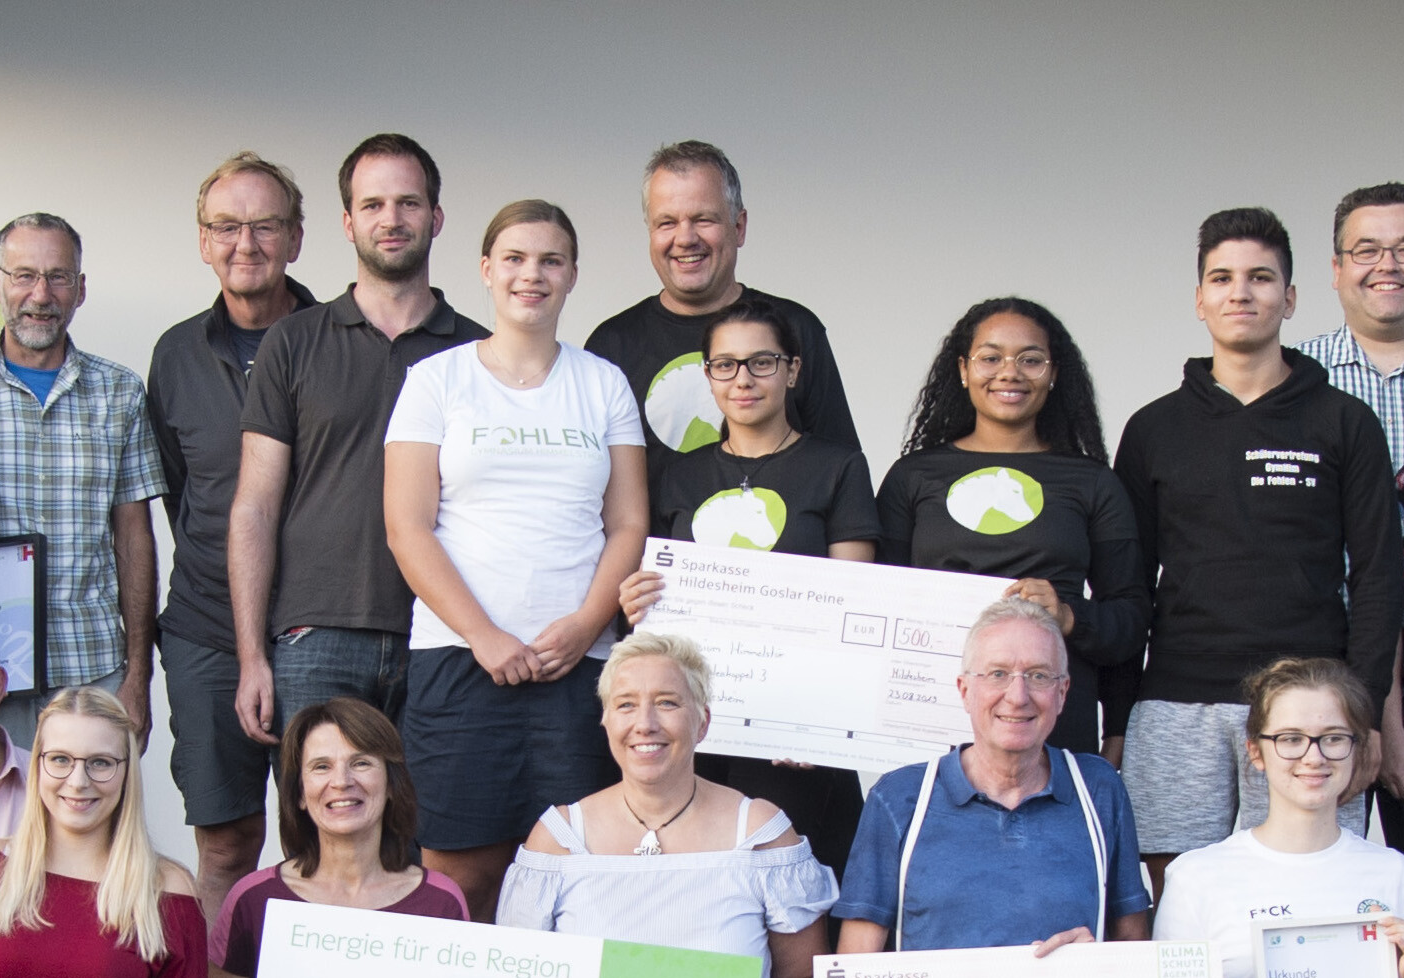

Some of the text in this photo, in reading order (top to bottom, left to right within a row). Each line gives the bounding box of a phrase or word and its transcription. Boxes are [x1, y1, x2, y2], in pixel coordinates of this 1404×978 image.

[681, 559, 750, 577] Sparkasse
[679, 577, 845, 606] Hildesheim Goslar Peine
[291, 923, 385, 960] Energie
[393, 936, 430, 962] für
[437, 943, 477, 968] die
[1161, 946, 1204, 958] KLIMA
[1162, 959, 1205, 968] SCHUTZ
[1163, 970, 1205, 978] AGENTUR
